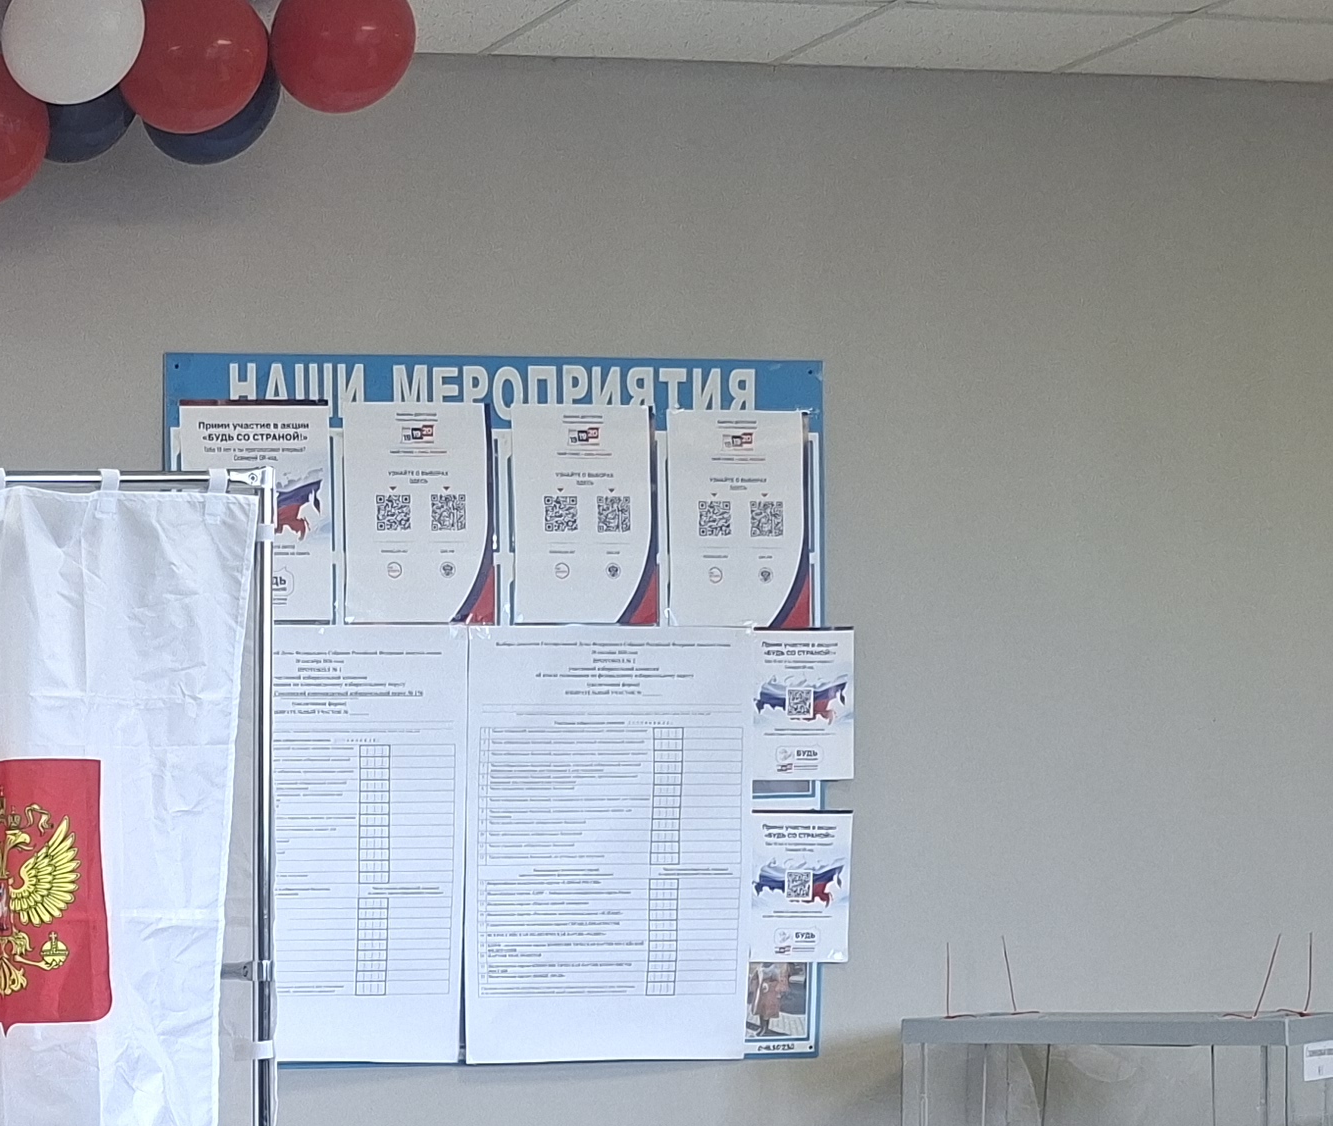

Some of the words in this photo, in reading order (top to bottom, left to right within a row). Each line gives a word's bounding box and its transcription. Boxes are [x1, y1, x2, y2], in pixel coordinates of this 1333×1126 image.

[229, 362, 364, 418] НАШИ
[393, 364, 756, 420] МЕРОПРИЯТИЯ
[198, 421, 230, 431] Прими
[232, 422, 271, 431] участие
[202, 433, 234, 442] «БУДЬ
[236, 433, 250, 441] СО
